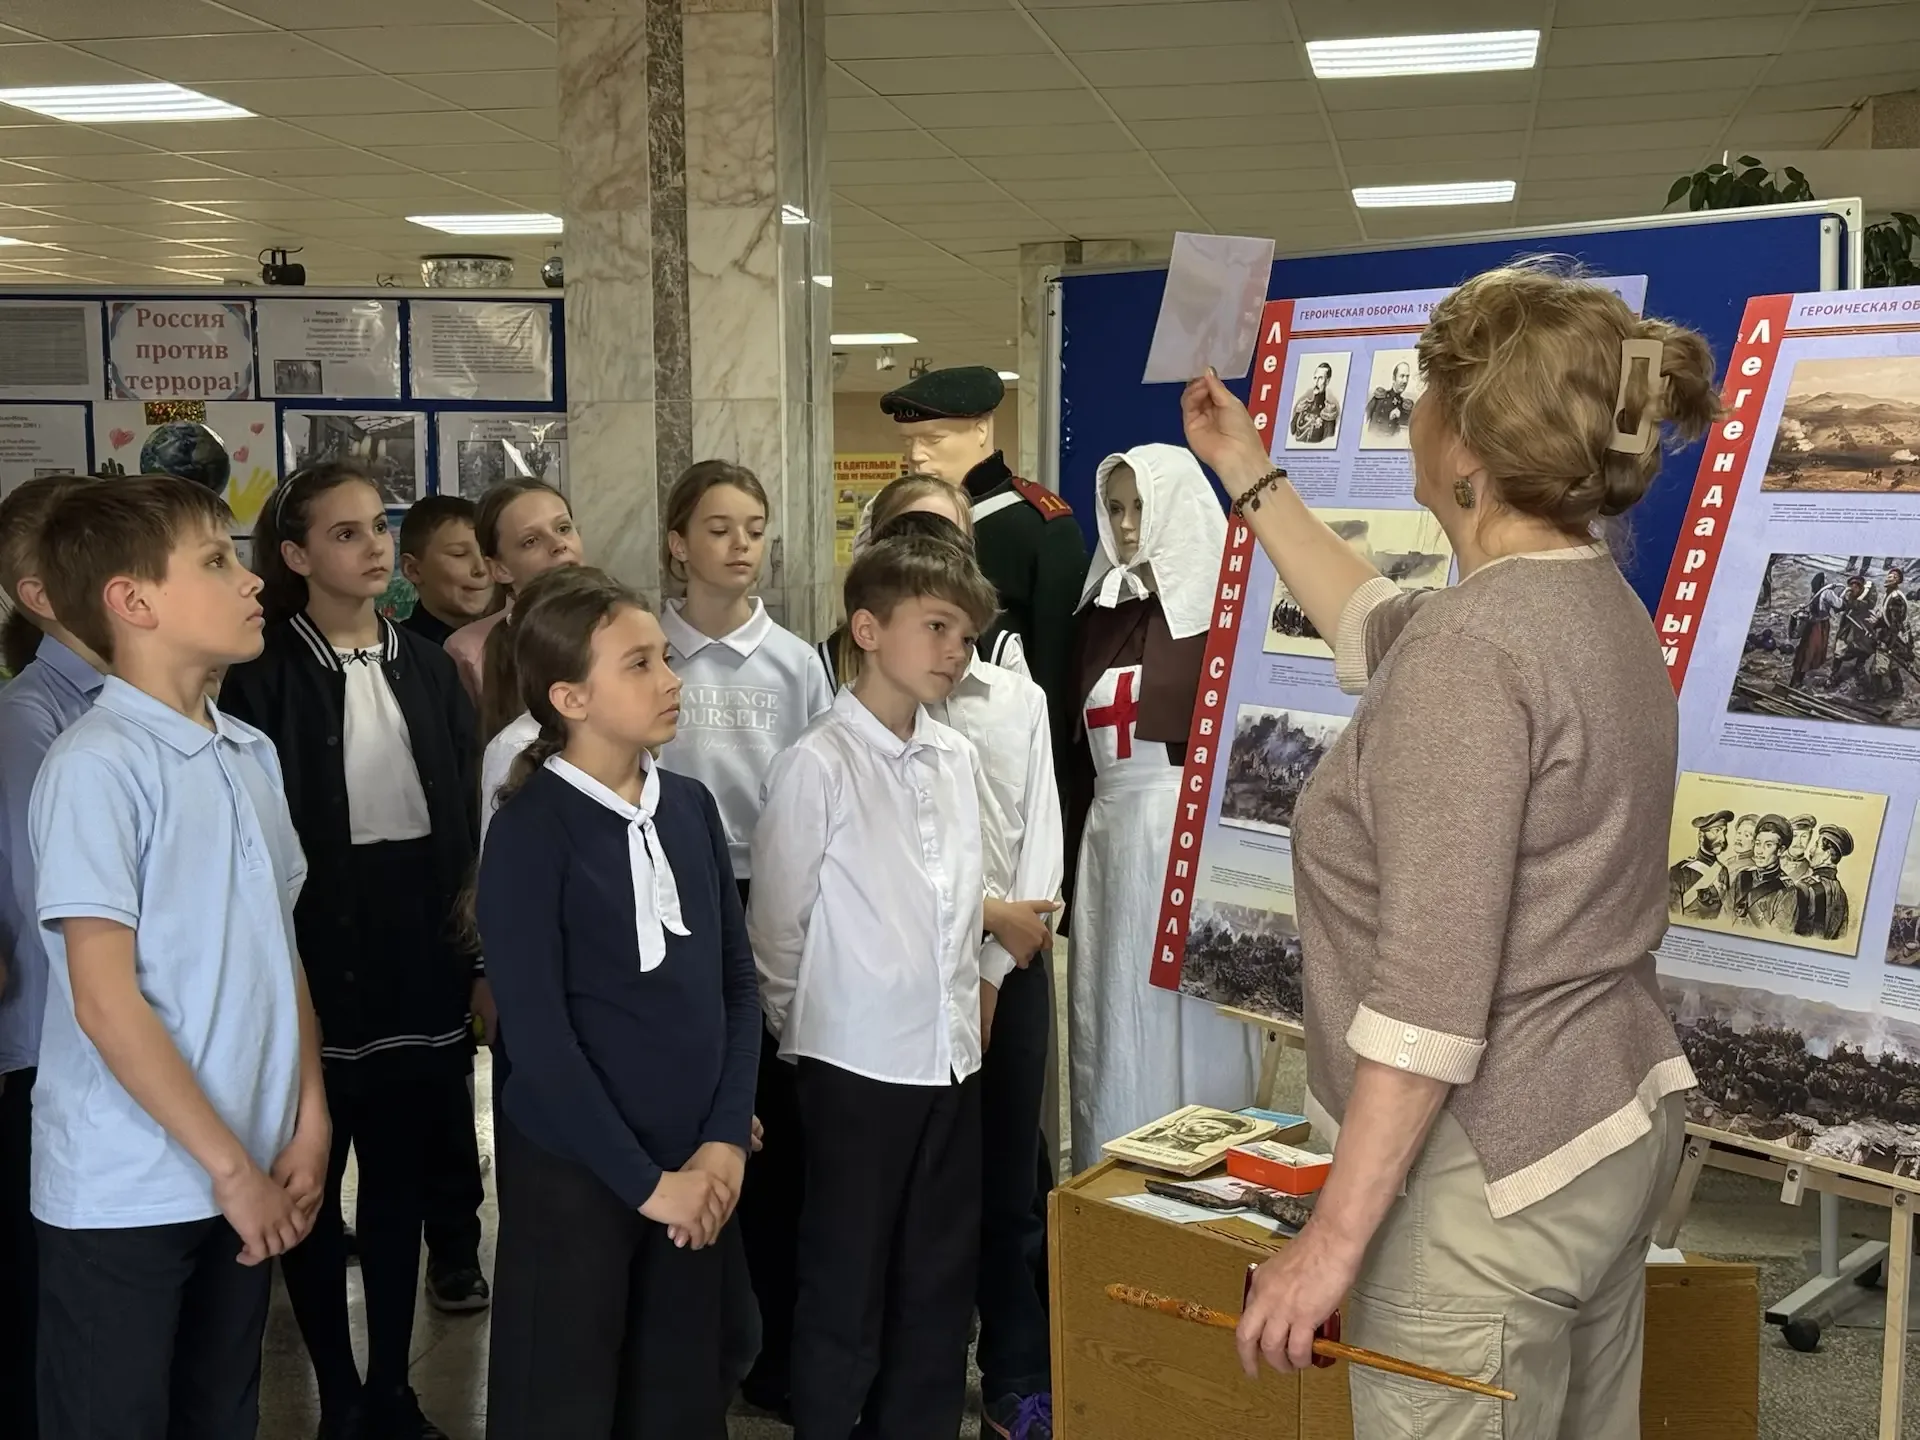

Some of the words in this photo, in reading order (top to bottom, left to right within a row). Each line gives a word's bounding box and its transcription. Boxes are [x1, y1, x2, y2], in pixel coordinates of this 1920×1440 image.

[135, 307, 226, 328] Россия
[1300, 307, 1364, 320] ГЕРОИЧЕСКАЯ
[1366, 304, 1415, 316] ОБОРОНА
[1800, 301, 1898, 317] ГЕРОИЧЕСКАЯ
[135, 343, 229, 365] против
[124, 371, 240, 396] террора!
[1217, 321, 1283, 629] Легерный
[1660, 318, 1772, 667] Легендарный
[1161, 656, 1226, 963] Севастополь
